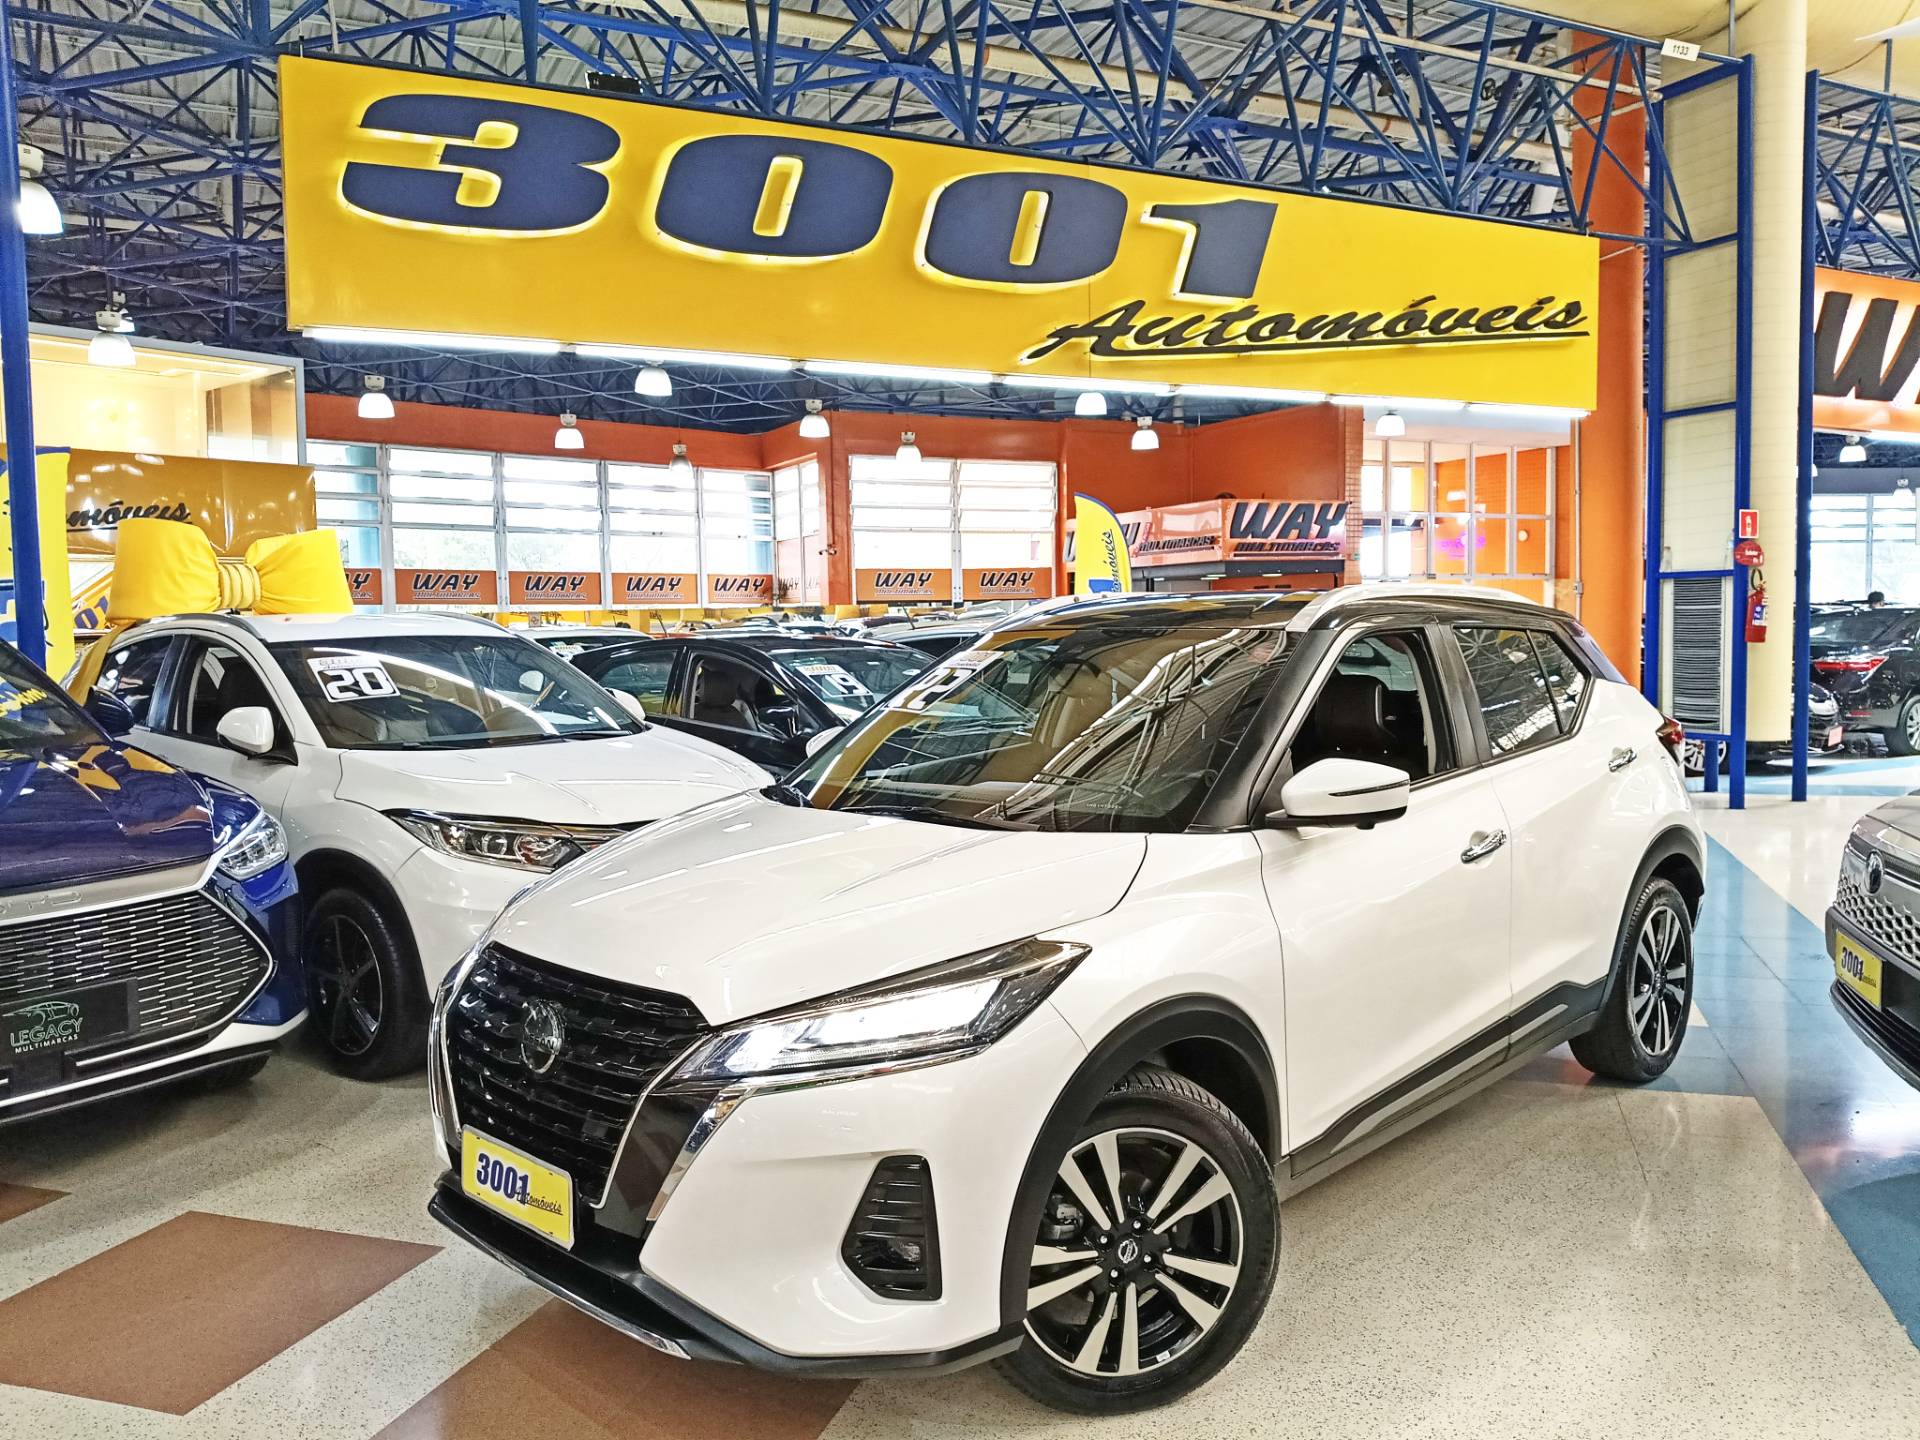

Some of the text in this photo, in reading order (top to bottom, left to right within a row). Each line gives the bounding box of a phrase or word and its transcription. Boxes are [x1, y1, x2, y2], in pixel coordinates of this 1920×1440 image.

[1672, 44, 1690, 56] 1133
[339, 94, 1278, 300] 3001
[1021, 296, 1590, 358] Automóveis
[1814, 291, 1920, 403] W
[1229, 502, 1349, 539] WAY
[412, 573, 480, 590] WAY
[524, 575, 586, 592] WAY
[626, 576, 682, 592] WAY
[713, 577, 766, 592] WAY
[875, 572, 933, 588] WAY
[980, 571, 1034, 588] WAY
[318, 667, 397, 699] 20
[822, 673, 870, 695] 19
[1842, 946, 1864, 981] 3001
[10, 1017, 83, 1047] LEGACY
[15, 1033, 79, 1054] MULTIMARCAS
[476, 1153, 529, 1205] 3001
